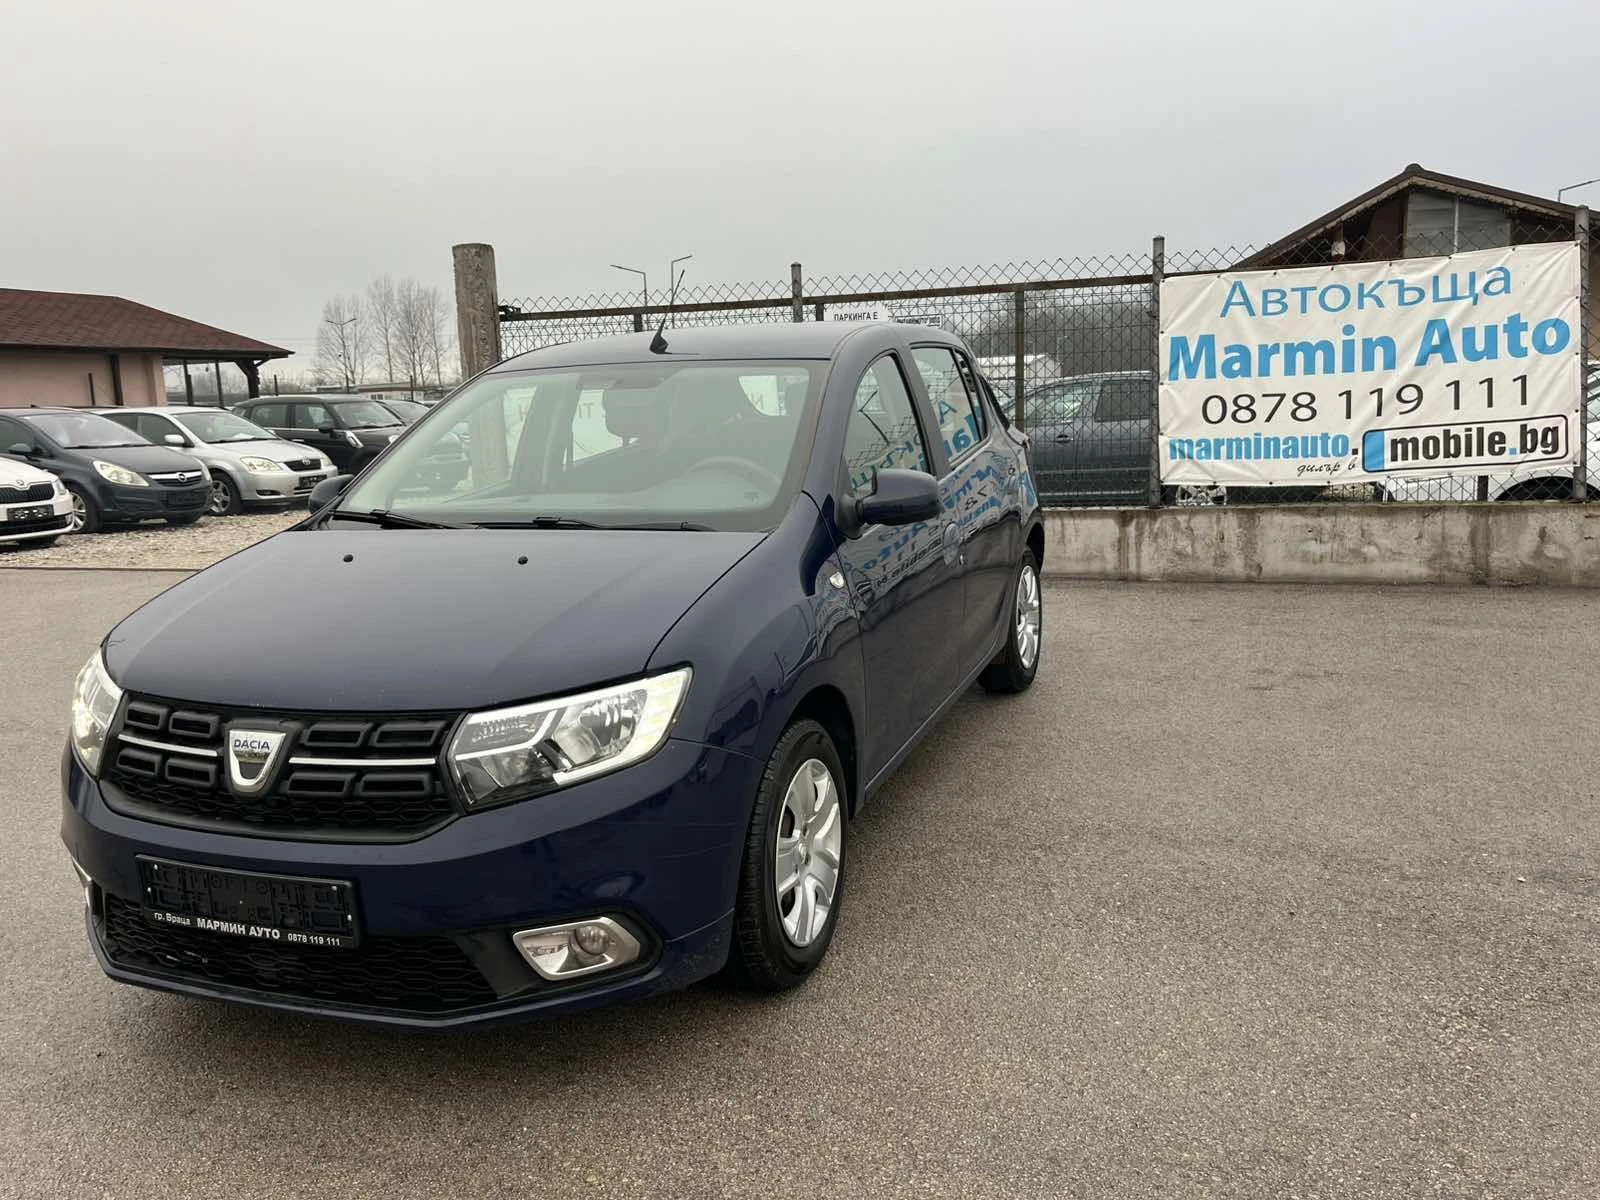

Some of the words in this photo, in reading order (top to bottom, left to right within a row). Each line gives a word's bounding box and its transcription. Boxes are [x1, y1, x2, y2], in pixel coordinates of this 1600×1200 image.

[1219, 265, 1512, 318] Автокъща
[834, 312, 871, 321] ПАРКИНГА
[1168, 324, 1397, 381] Marmin
[1415, 312, 1571, 367] Auto
[1201, 391, 1318, 424] 0878
[1338, 383, 1424, 420] 119
[1445, 374, 1530, 411] 111
[1390, 424, 1560, 462] mobile.bg
[233, 739, 270, 750] DACIA
[196, 918, 246, 935] МАРМИН
[249, 926, 280, 939] АУТО
[309, 936, 324, 944] 119
[326, 937, 340, 946] 111
